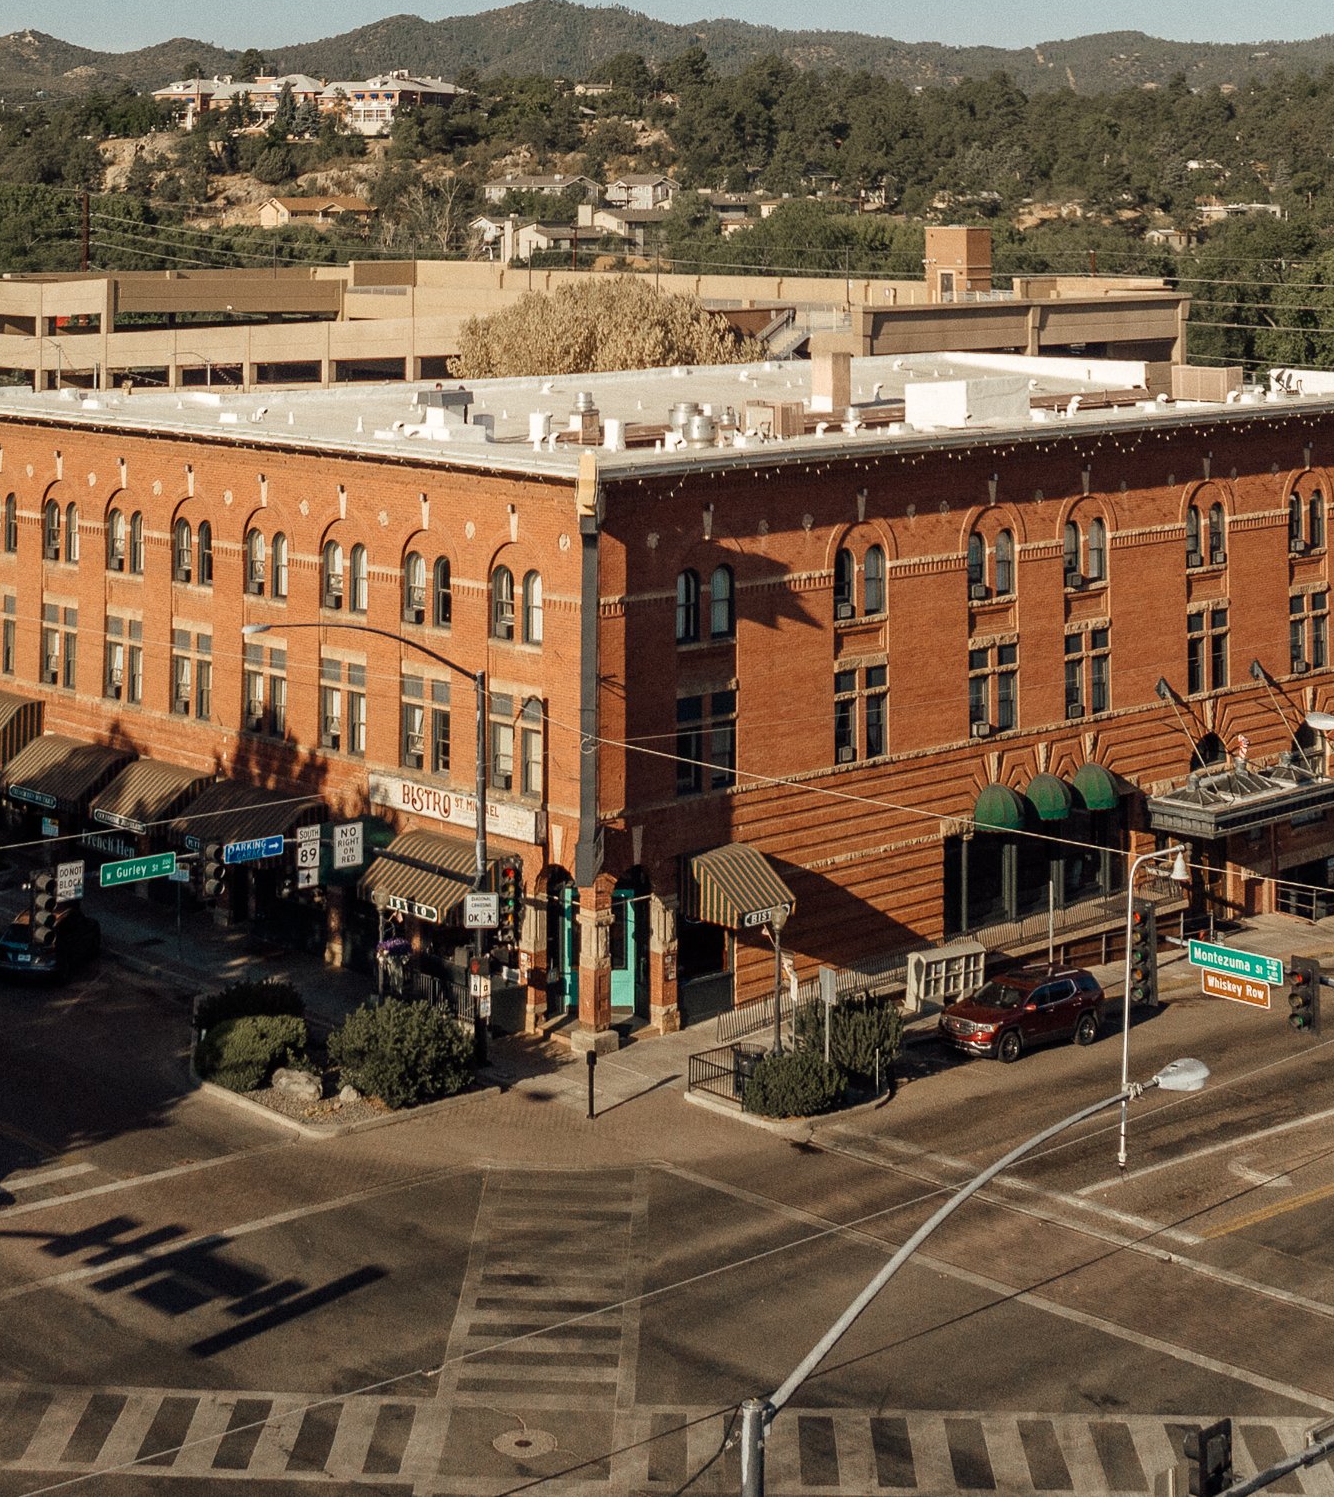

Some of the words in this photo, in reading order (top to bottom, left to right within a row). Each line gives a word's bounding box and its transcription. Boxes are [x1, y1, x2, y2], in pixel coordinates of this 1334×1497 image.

[402, 784, 451, 818] BISTRO
[467, 799, 499, 818] MIAEL
[300, 830, 318, 839] SOUTH
[341, 827, 356, 839] NO
[82, 829, 113, 852] French
[116, 839, 135, 858] Hen
[338, 837, 359, 847] RIGHT
[227, 840, 266, 863] PARKING
[301, 848, 317, 863] 89
[343, 845, 354, 855] ON
[341, 854, 356, 864] RED
[59, 869, 69, 878] DO
[70, 866, 82, 876] NOT
[117, 865, 147, 879] Gurley
[59, 878, 82, 889] BLOCK
[468, 913, 480, 923] OK
[1194, 946, 1251, 972] Montezuma
[1207, 975, 1243, 998] Whiskey
[1246, 984, 1265, 1000] Row
